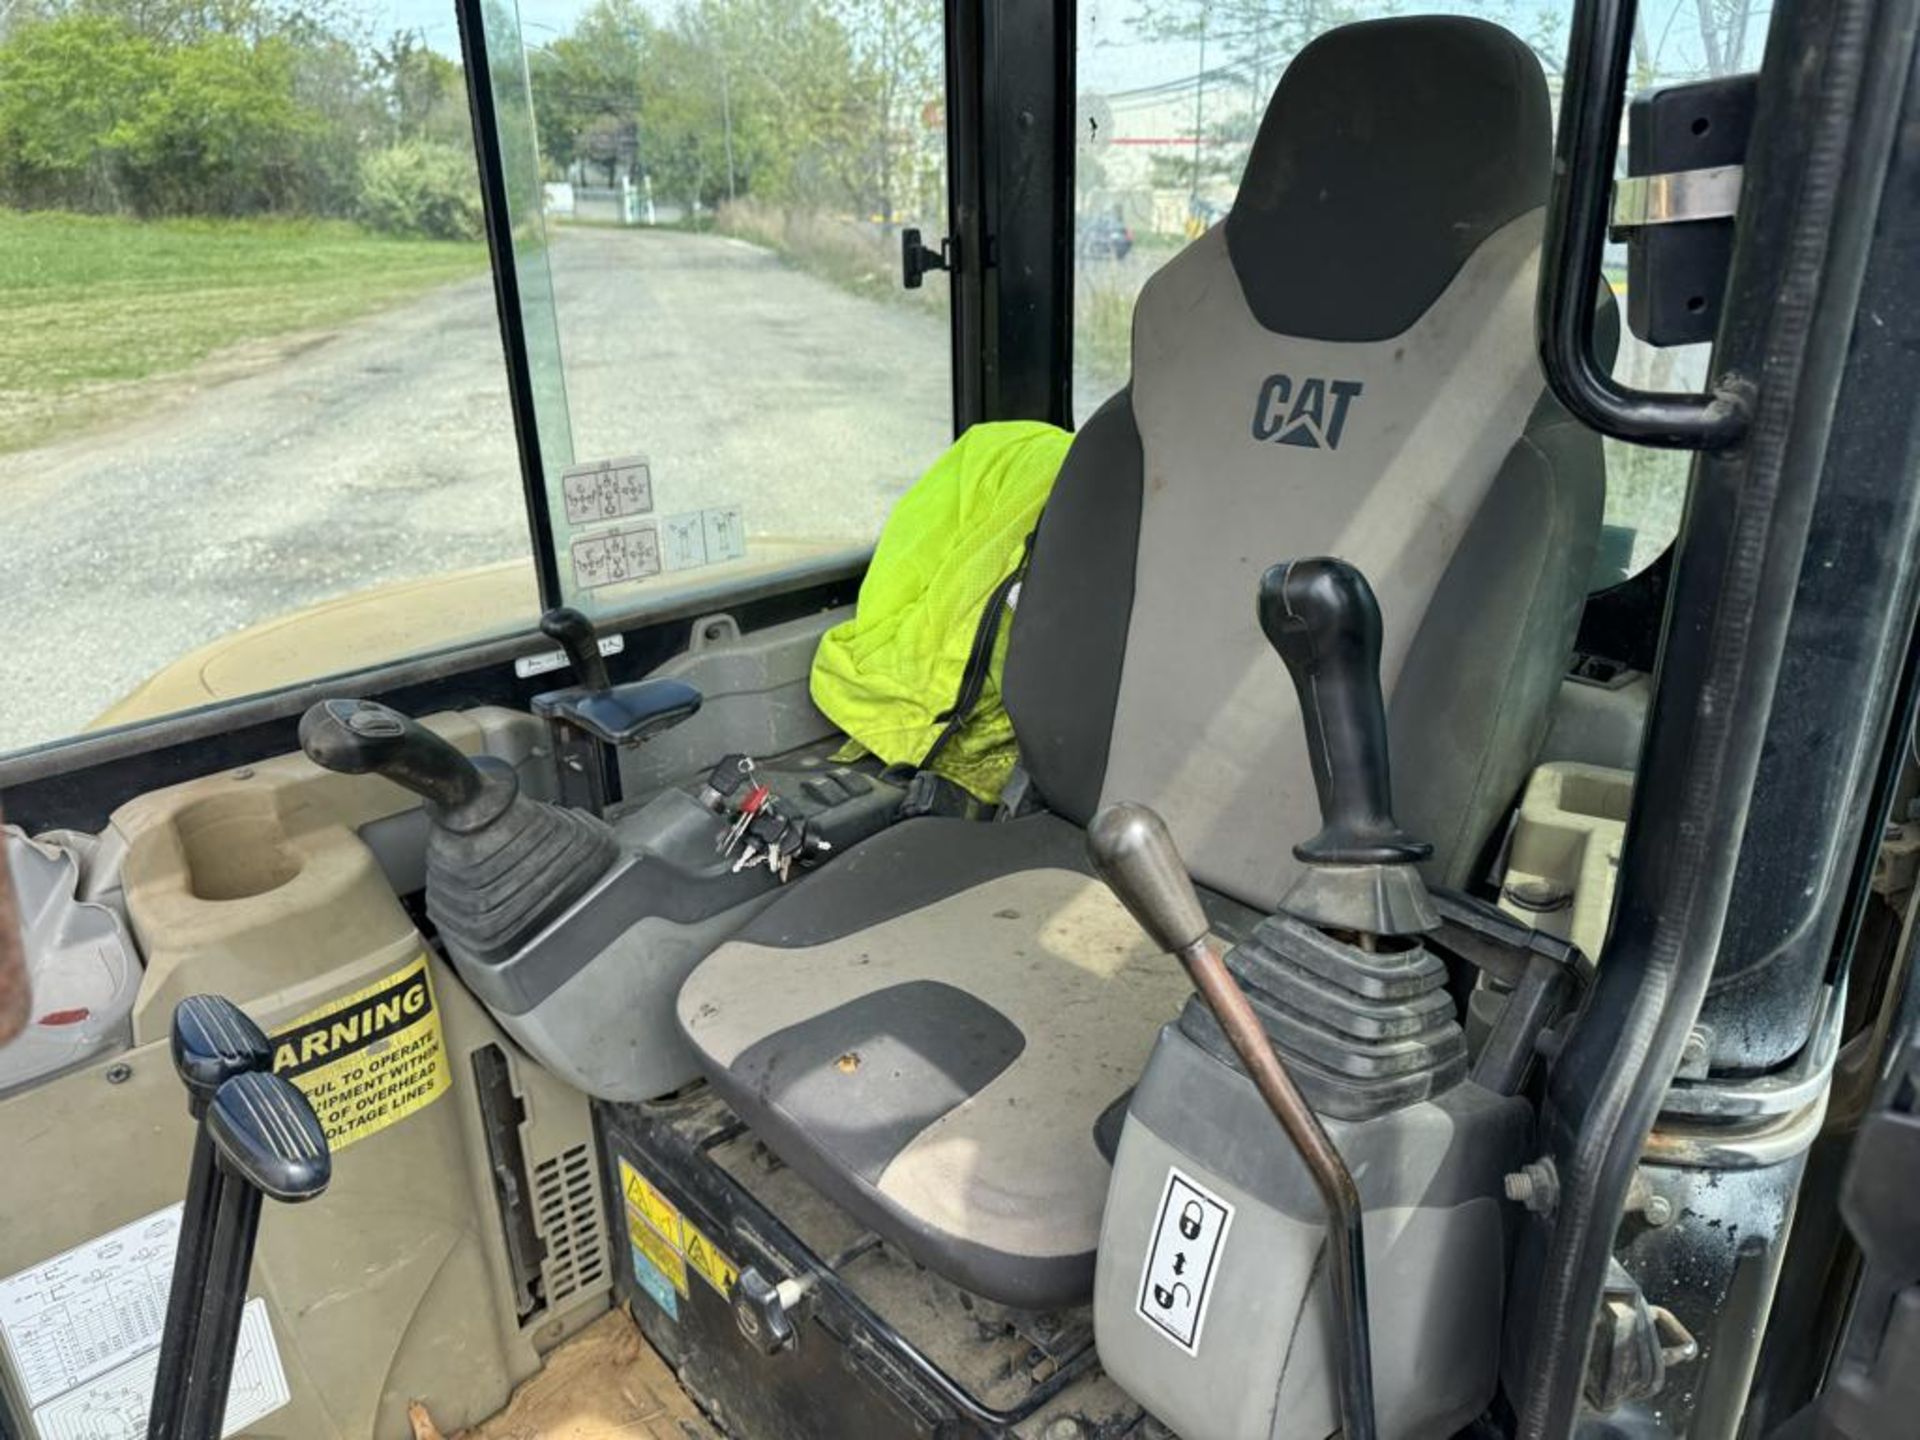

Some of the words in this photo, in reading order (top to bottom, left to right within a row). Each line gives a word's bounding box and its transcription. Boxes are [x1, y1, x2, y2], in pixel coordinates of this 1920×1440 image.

[1252, 374, 1363, 450] CAT
[272, 984, 425, 1074] ARNING
[341, 1068, 364, 1085] TO
[368, 1029, 434, 1073] OPERATE
[325, 1104, 389, 1139] OLTAGE
[392, 1078, 435, 1109] LINES
[328, 1105, 352, 1123] OF
[355, 1061, 436, 1112] OVERHEAD
